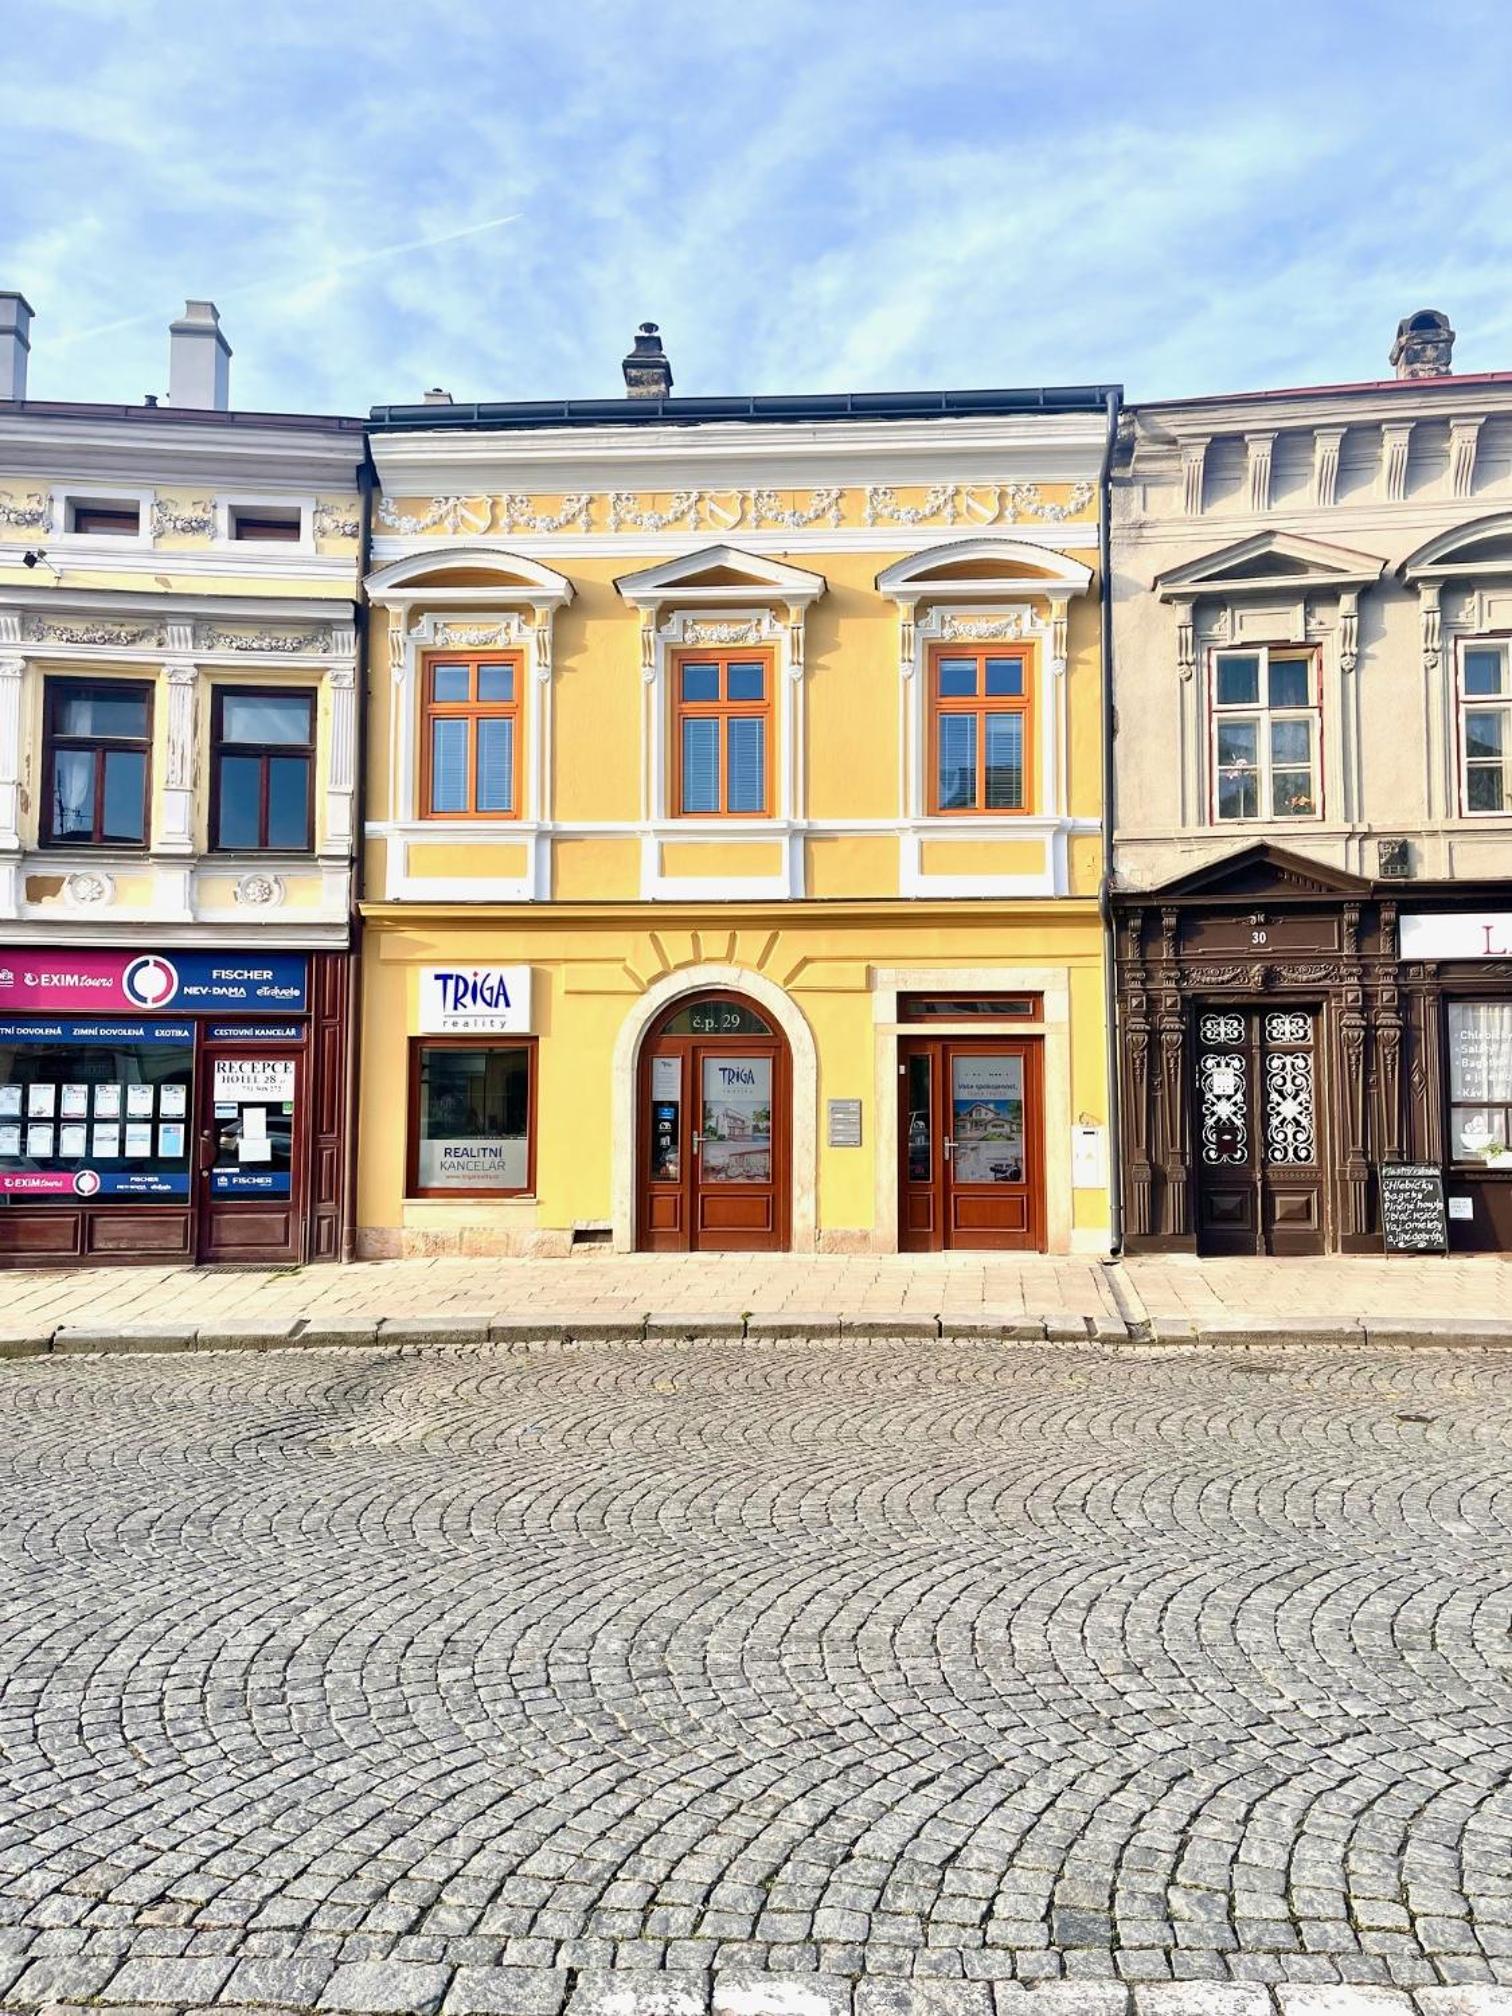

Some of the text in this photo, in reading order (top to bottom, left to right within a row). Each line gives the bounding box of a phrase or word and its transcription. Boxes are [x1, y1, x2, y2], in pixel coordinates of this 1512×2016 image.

[1252, 932, 1267, 944] 30
[1482, 925, 1512, 955] L
[212, 969, 273, 980] FISCHER
[183, 986, 247, 998] NEV-DAMA
[443, 1019, 506, 1028] reality
[693, 1014, 740, 1031] č.p. 29
[16, 1026, 62, 1036] DOVOLENÁ
[72, 1027, 145, 1036] ZIMNÍ DOVOLENÁ
[216, 1061, 293, 1074] RECEPCE
[444, 1145, 503, 1158] REALITNÍ
